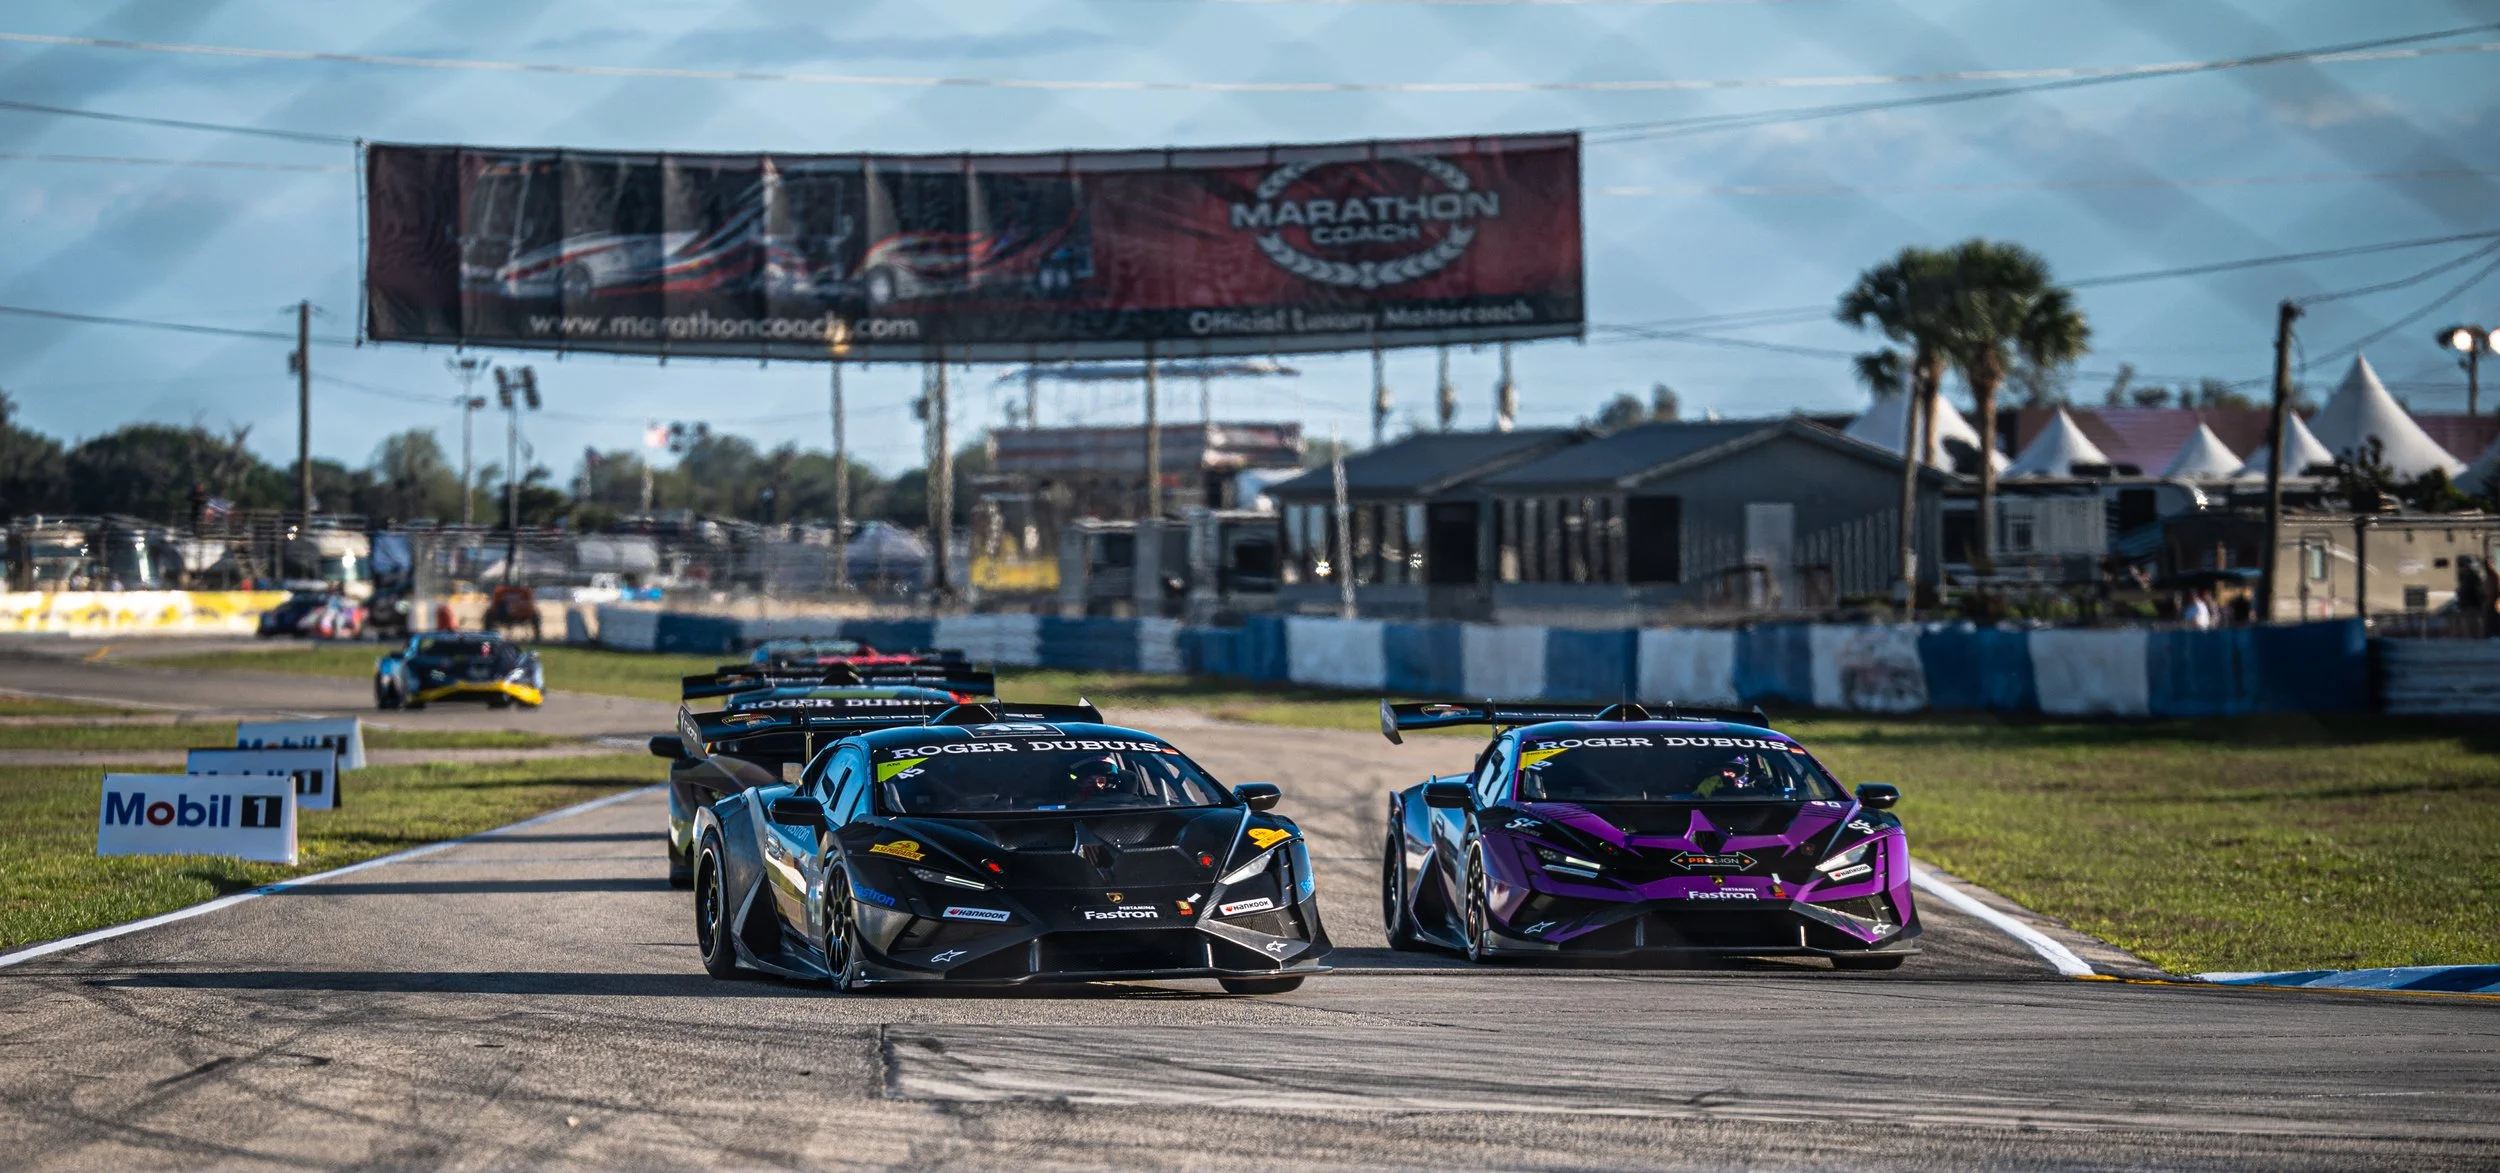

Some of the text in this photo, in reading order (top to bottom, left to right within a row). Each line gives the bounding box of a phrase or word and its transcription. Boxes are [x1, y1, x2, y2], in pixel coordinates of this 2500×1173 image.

[1230, 191, 1499, 228] MARATHON
[1312, 223, 1420, 245] COACH
[529, 309, 920, 339] www.marathoncoach.com
[1189, 299, 1534, 335] Official Luxury Motorcoach
[741, 699, 834, 709] ROGER
[891, 741, 1161, 759] ROGER DUBUIS
[1536, 737, 1788, 750] ROGER DUBUIS
[105, 791, 231, 827] Mobil
[853, 881, 896, 907] Fastron
[1688, 891, 1757, 899] Fastron
[1084, 910, 1159, 920] Fastron
